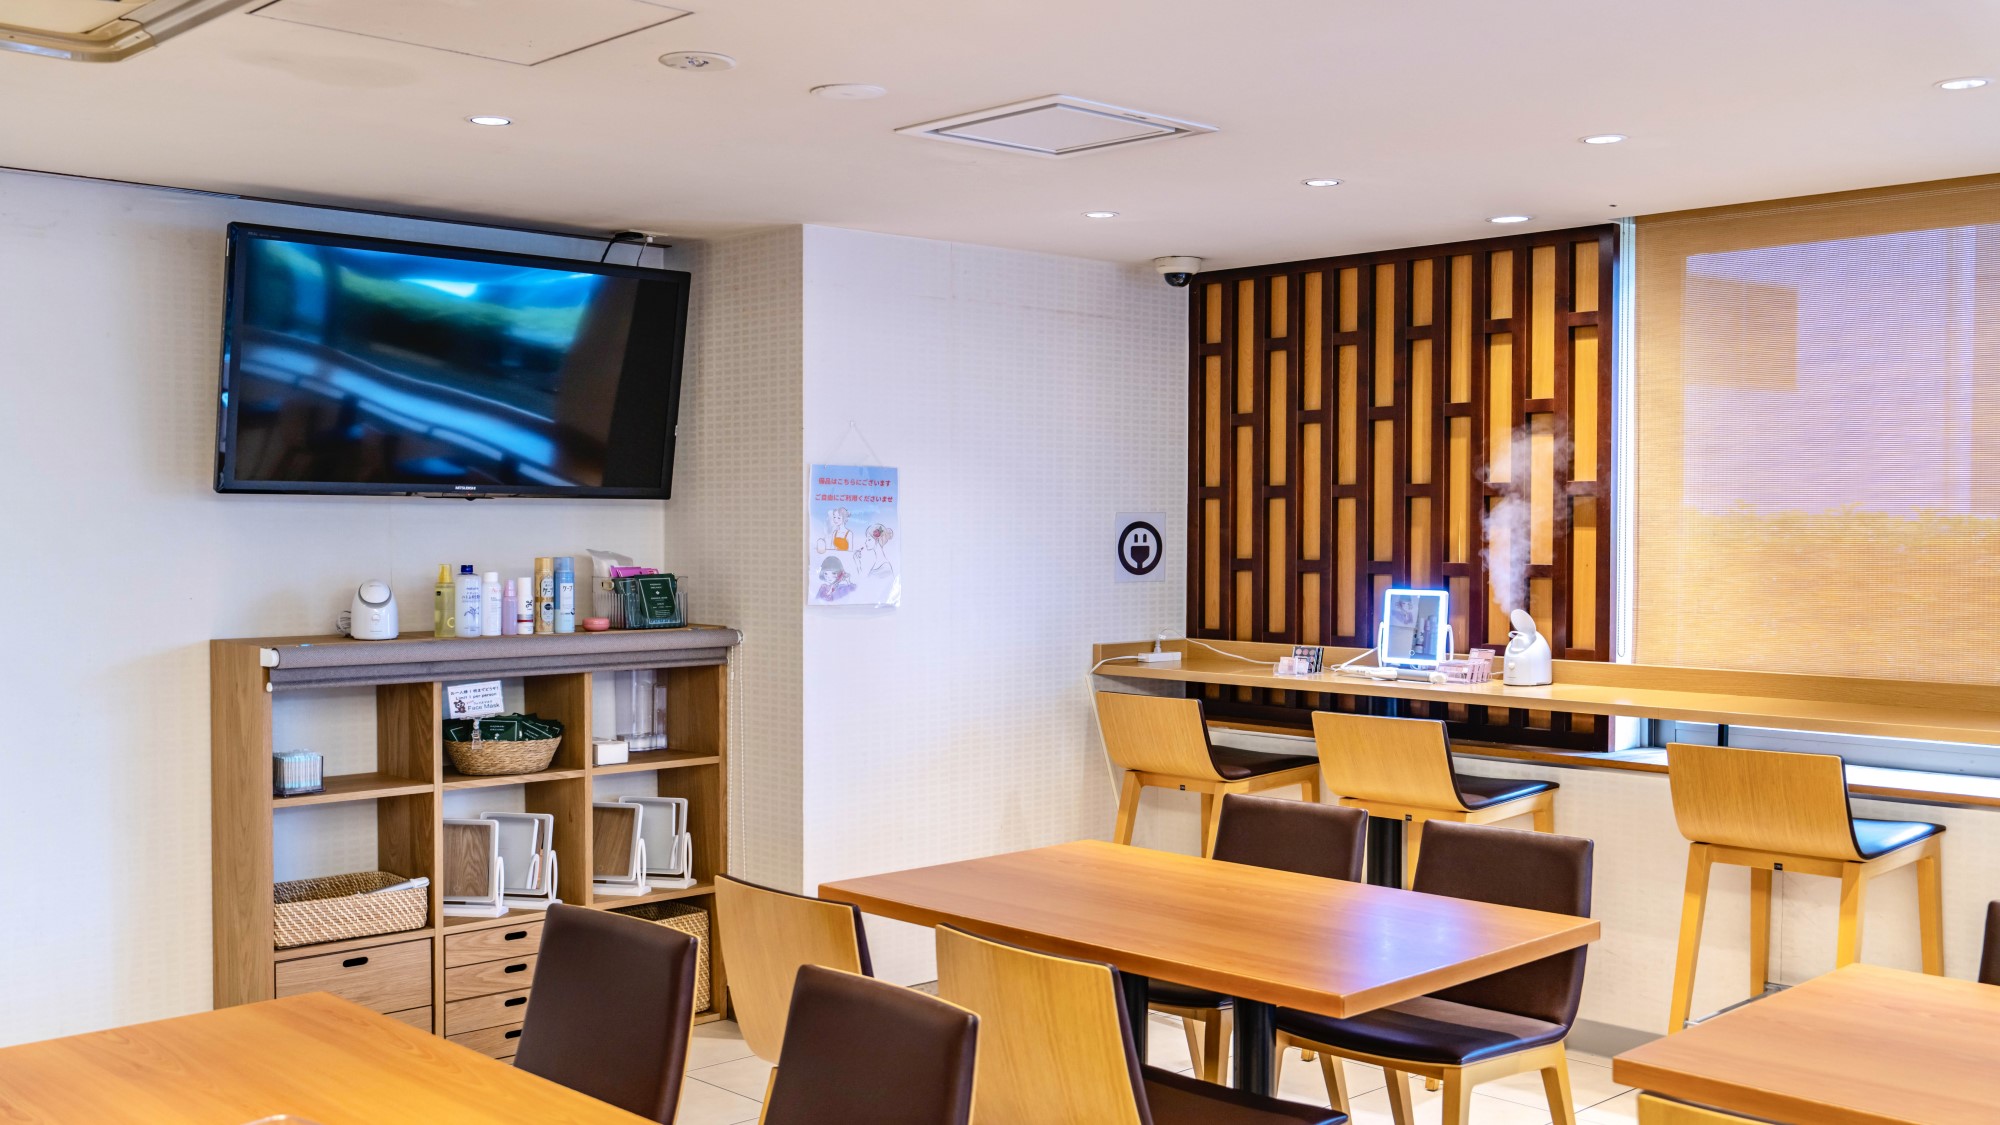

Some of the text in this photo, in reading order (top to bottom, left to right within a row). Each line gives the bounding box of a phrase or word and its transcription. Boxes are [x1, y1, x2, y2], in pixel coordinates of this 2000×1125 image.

[815, 493, 893, 503] ご自由にご利用くださいませ
